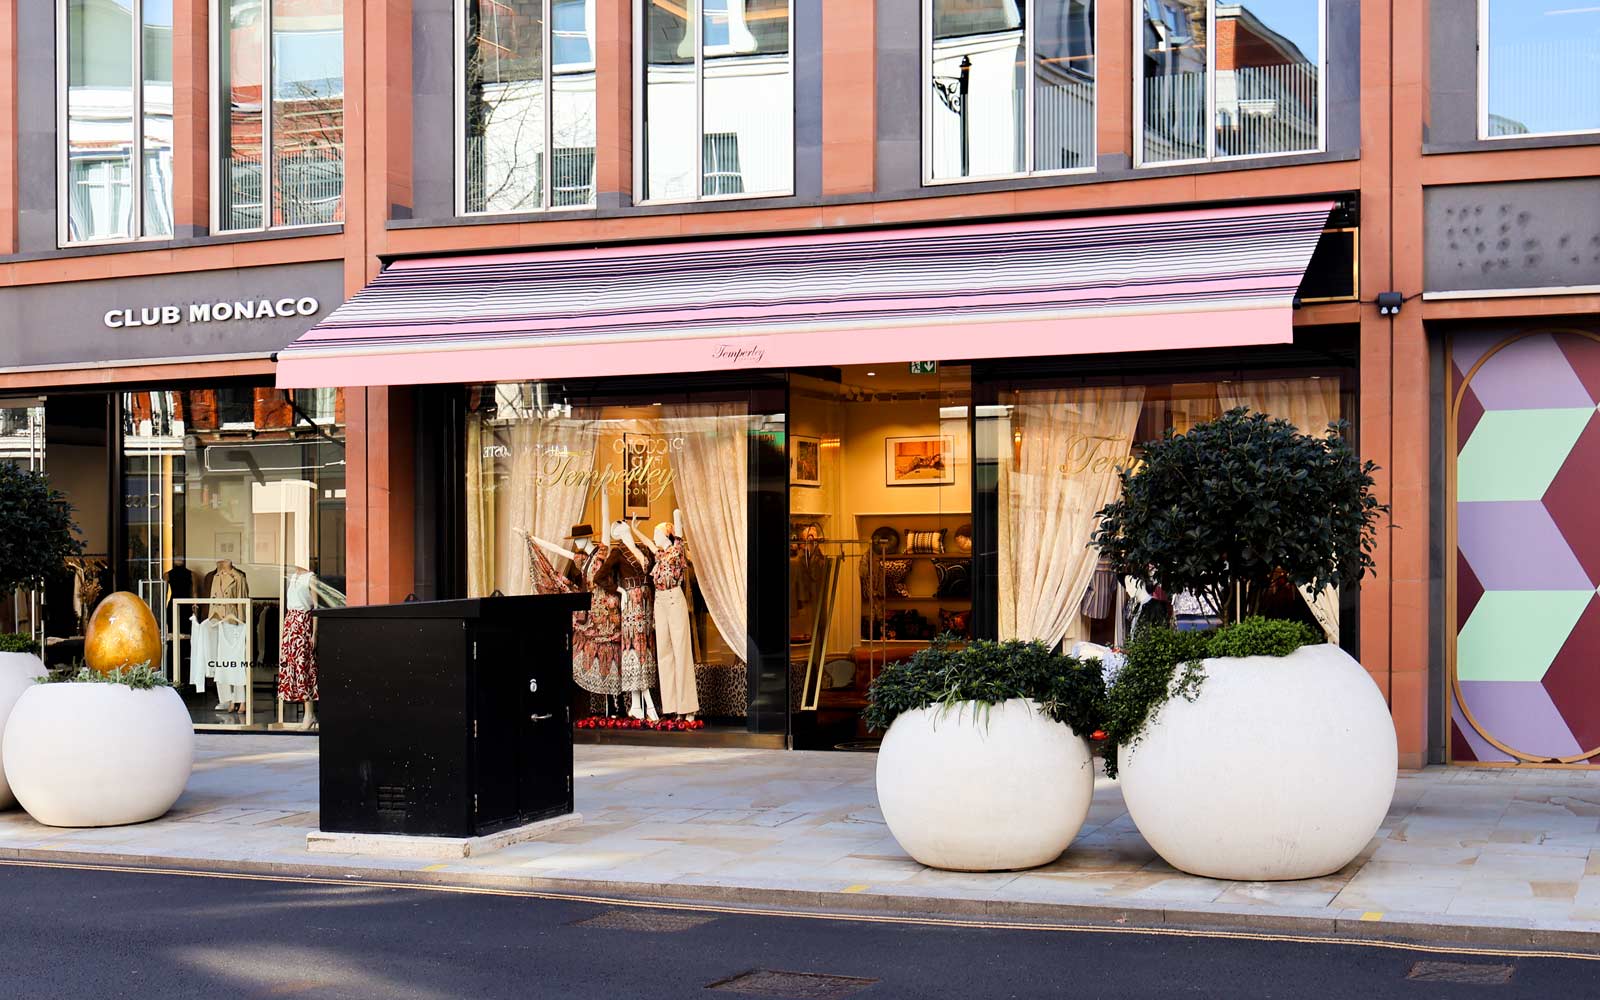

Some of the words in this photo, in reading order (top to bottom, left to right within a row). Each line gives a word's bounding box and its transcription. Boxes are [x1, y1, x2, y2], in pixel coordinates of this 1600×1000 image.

[104, 306, 181, 328] CLUB
[189, 297, 319, 322] MONACO
[712, 344, 765, 363] Temperley
[536, 449, 678, 502] Temperley
